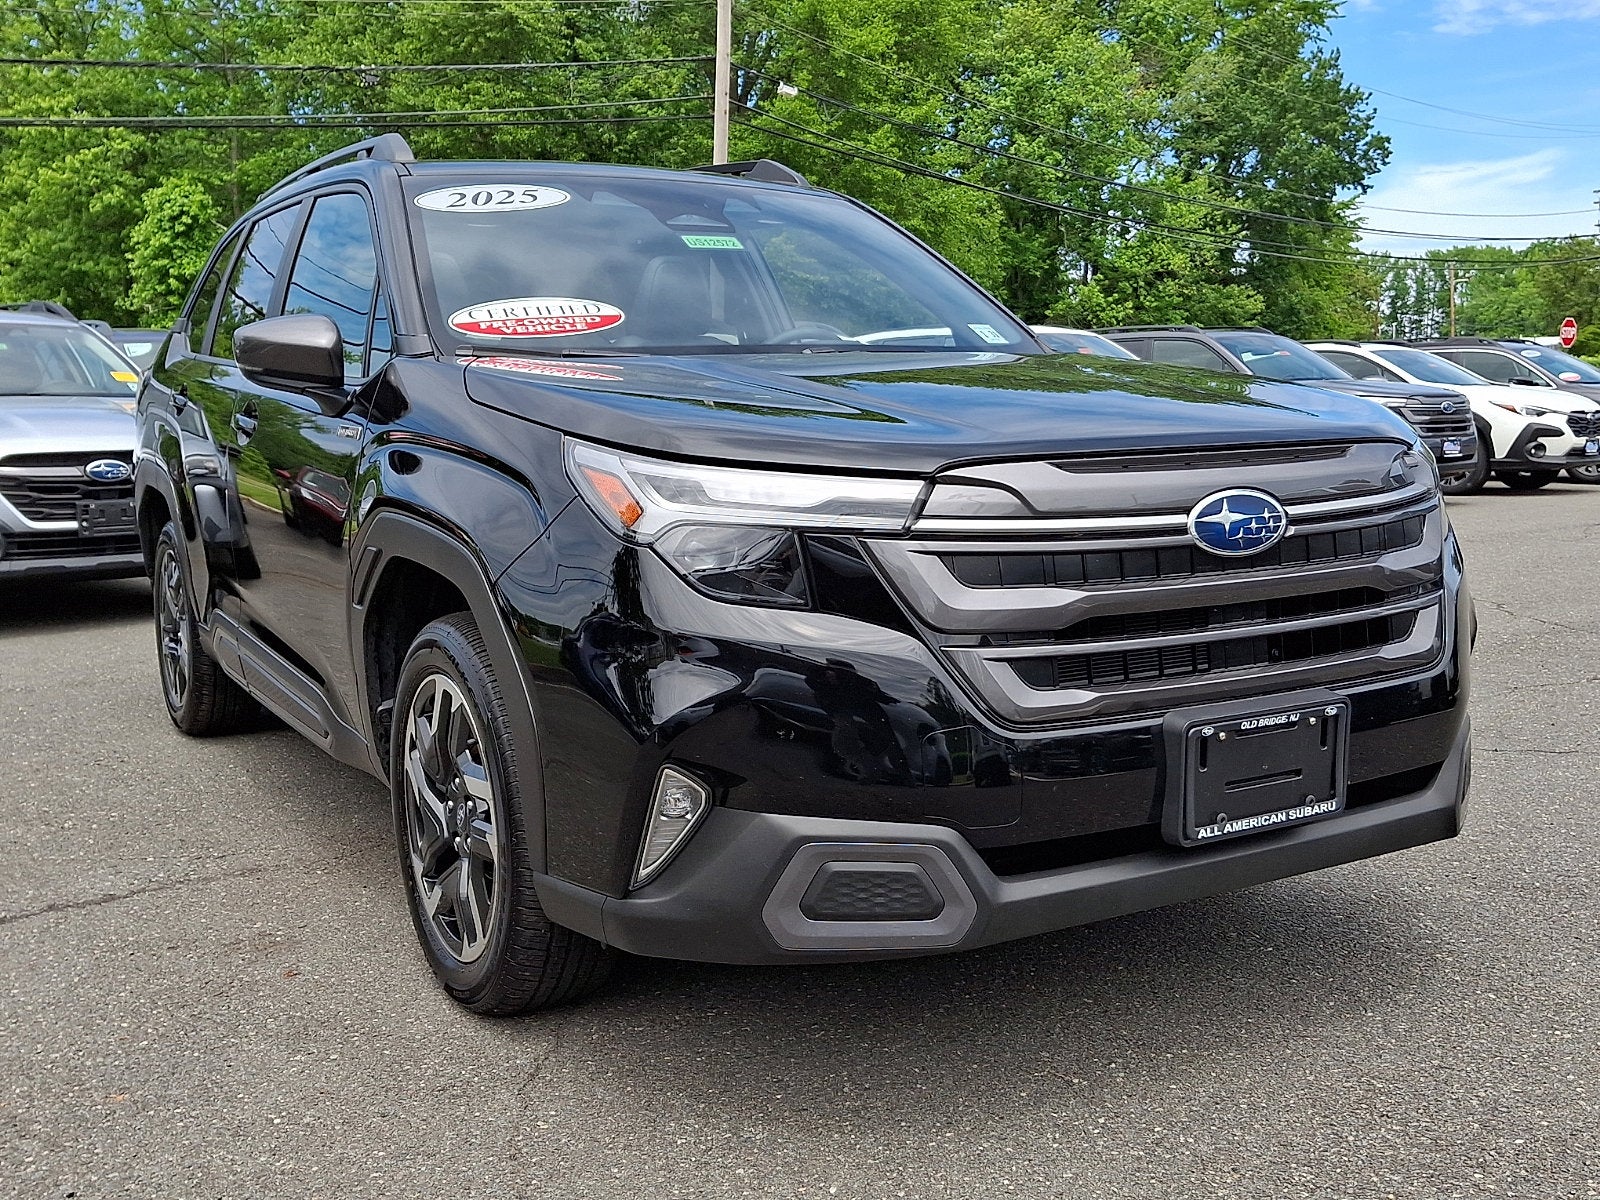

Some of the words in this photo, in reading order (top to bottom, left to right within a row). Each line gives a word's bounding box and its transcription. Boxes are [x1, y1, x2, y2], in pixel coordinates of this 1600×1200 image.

[446, 189, 538, 208] 2025
[468, 303, 601, 320] CERTIFIED
[478, 315, 601, 330] PRE-OWNED
[500, 322, 588, 334] VEHICLE
[1241, 720, 1258, 730] OLD
[1289, 713, 1300, 722] NJ
[1197, 826, 1223, 840] ALL
[1223, 812, 1286, 833] AMERICAN
[1288, 802, 1336, 819] SUBARU
